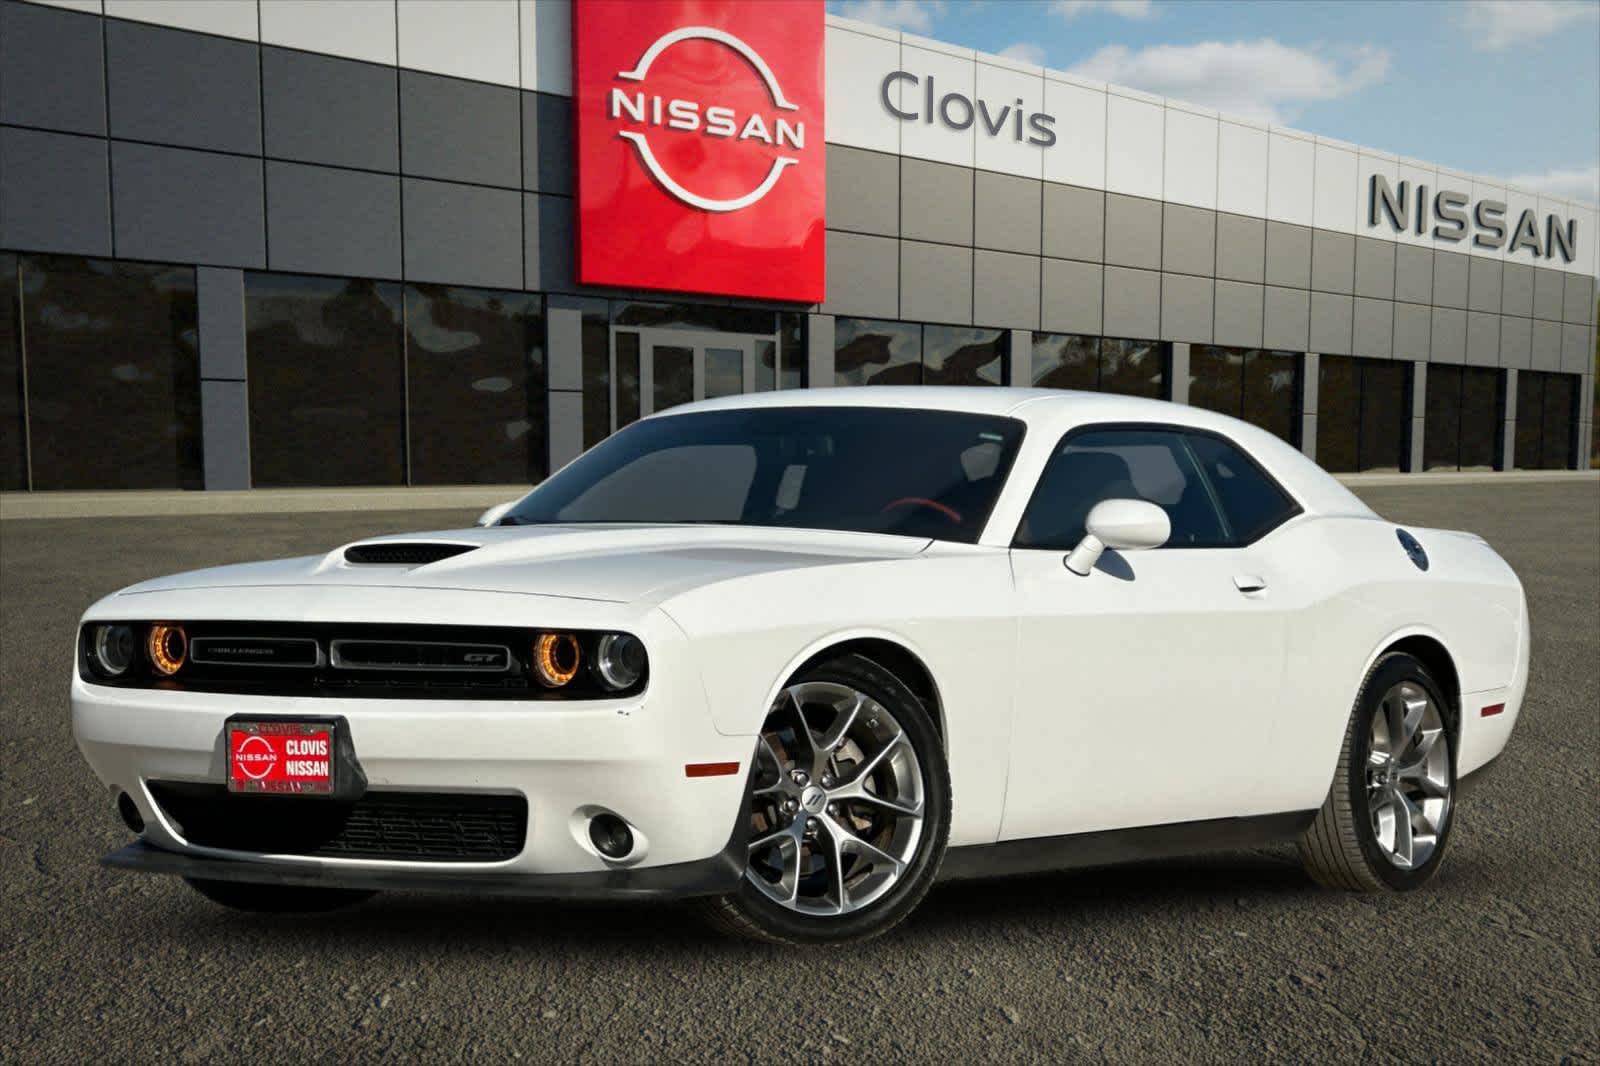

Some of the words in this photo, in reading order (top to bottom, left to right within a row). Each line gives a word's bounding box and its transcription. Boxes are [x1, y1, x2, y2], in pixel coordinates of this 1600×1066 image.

[611, 87, 805, 149] NISSAN
[881, 70, 1057, 147] Clovis
[1369, 173, 1578, 262] NISSAN
[235, 753, 277, 761] NISSAN
[285, 739, 327, 756] CLOVIS
[285, 760, 329, 776] NISSAN
